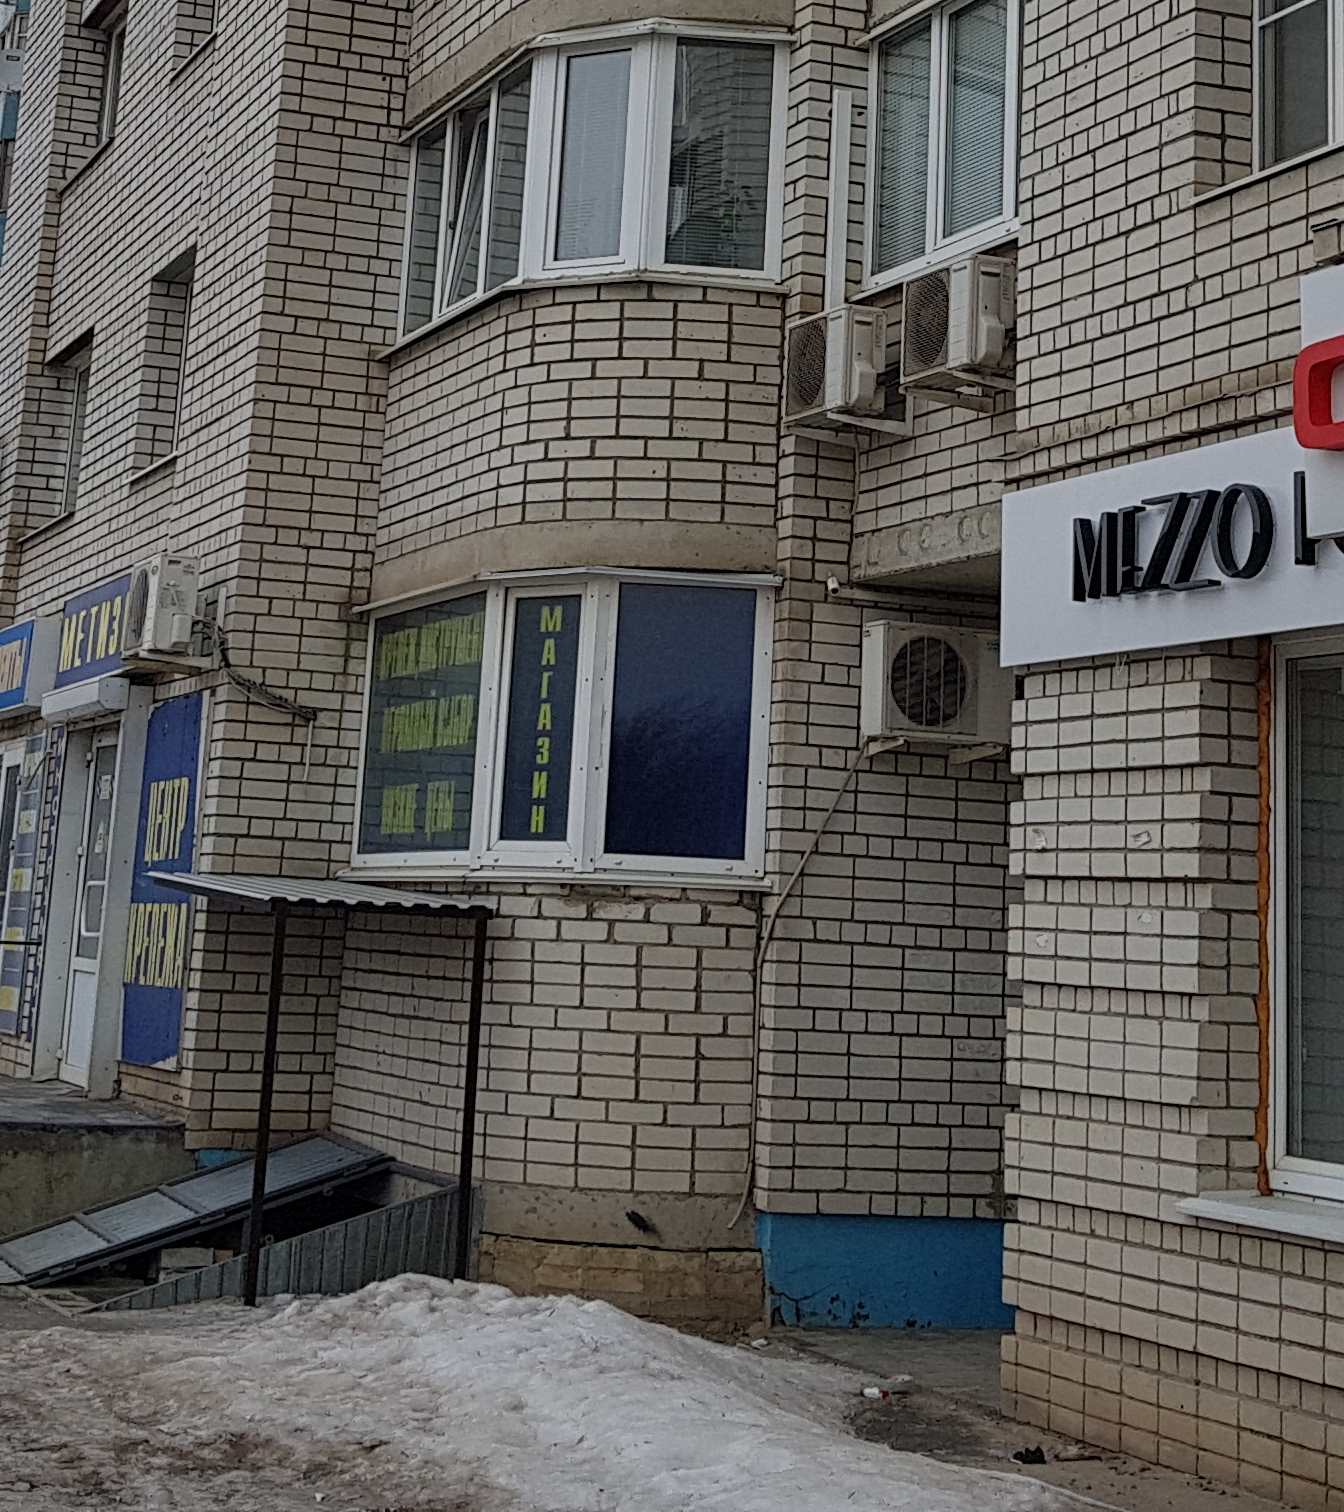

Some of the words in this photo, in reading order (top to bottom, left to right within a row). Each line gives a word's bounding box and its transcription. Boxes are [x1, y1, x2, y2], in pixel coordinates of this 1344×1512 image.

[1072, 483, 1274, 602] MEZZO
[529, 605, 563, 834] МАГАЗИН
[144, 777, 189, 867] ЦЕНТР
[424, 781, 456, 841] ЦЕНЫ
[124, 903, 188, 990] КРЕПЕЖА
